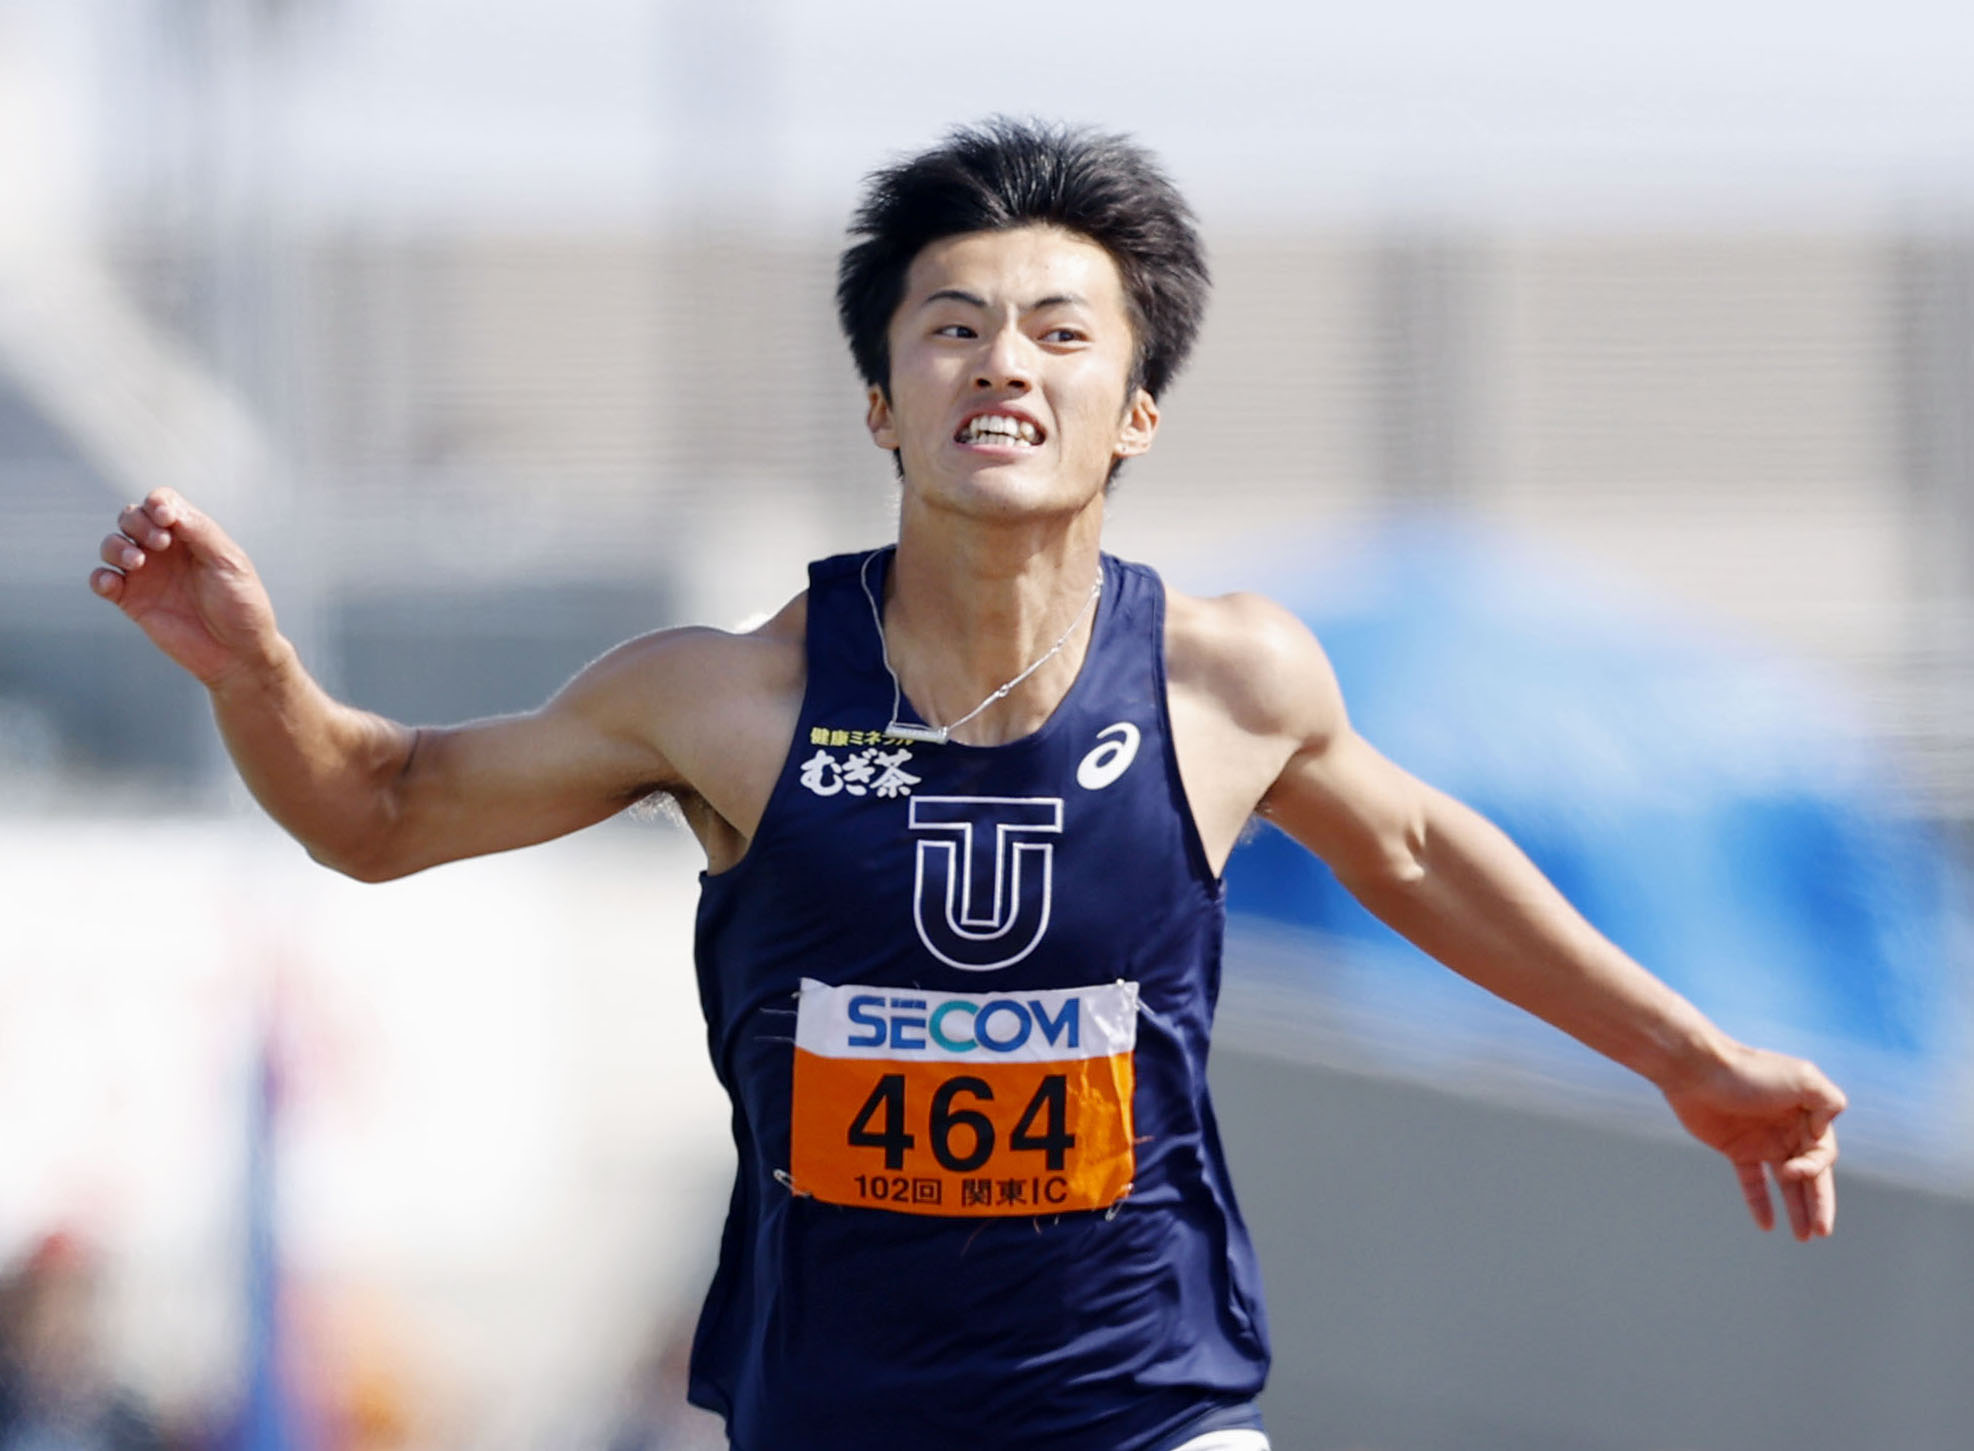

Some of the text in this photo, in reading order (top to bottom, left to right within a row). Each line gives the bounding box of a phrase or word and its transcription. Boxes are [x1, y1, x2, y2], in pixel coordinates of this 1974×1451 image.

[800, 748, 921, 797] むぎ茶
[847, 995, 1080, 1052] SECOM
[847, 1074, 1075, 1172] 464
[854, 1175, 942, 1205] 102回
